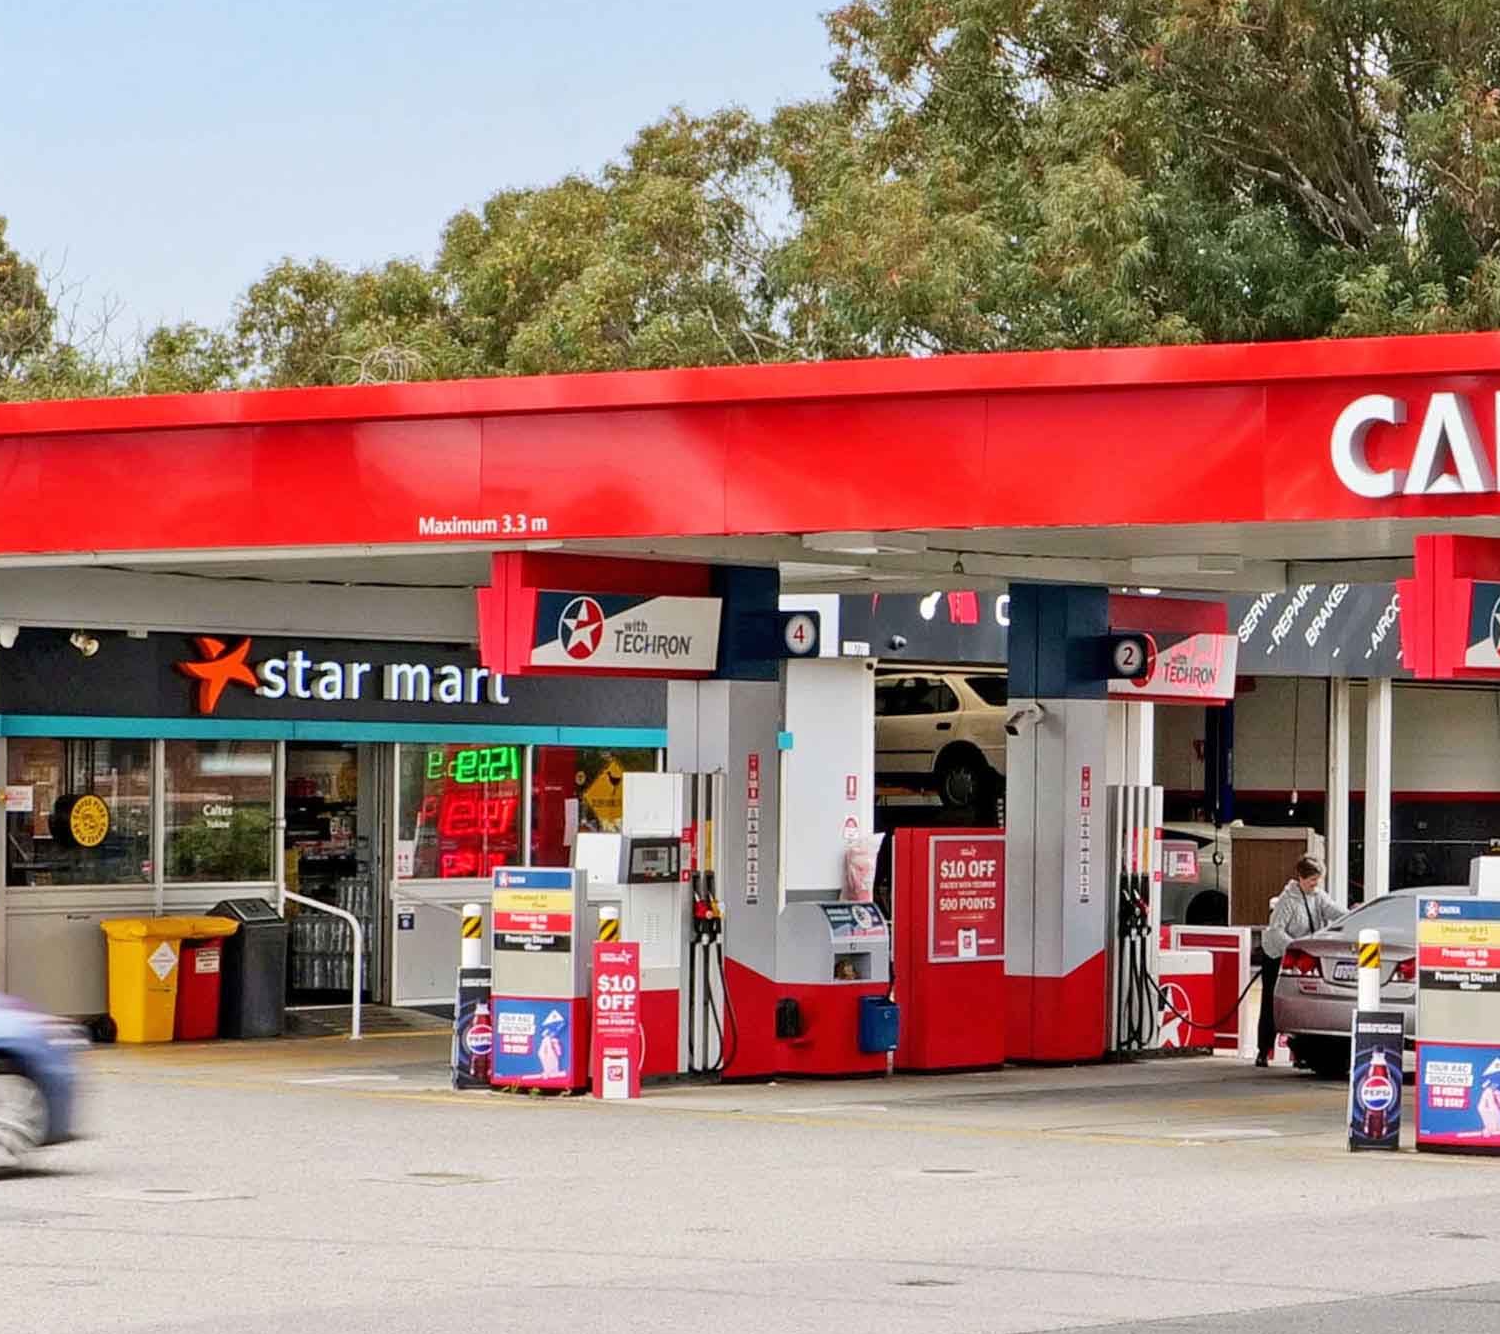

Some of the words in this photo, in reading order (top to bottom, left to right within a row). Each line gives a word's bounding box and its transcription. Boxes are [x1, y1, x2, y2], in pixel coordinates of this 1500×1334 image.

[418, 516, 497, 535] Maximum
[502, 514, 527, 533] 3.3
[531, 517, 548, 532] m
[624, 621, 648, 633] with
[793, 624, 805, 643] 4
[615, 630, 691, 659] TECHRON
[1122, 647, 1134, 665] 2
[256, 650, 371, 700] star
[383, 663, 510, 704] mart
[1164, 662, 1217, 688] TECHRON
[940, 859, 965, 879] $10
[968, 860, 997, 878] OFF
[959, 897, 997, 910] POINTS
[597, 974, 636, 992] $10
[1470, 973, 1497, 983] Diesel
[596, 994, 636, 1011] OFF
[1428, 1074, 1470, 1084] DISCOUNT
[1363, 1088, 1391, 1097] PEPSI
